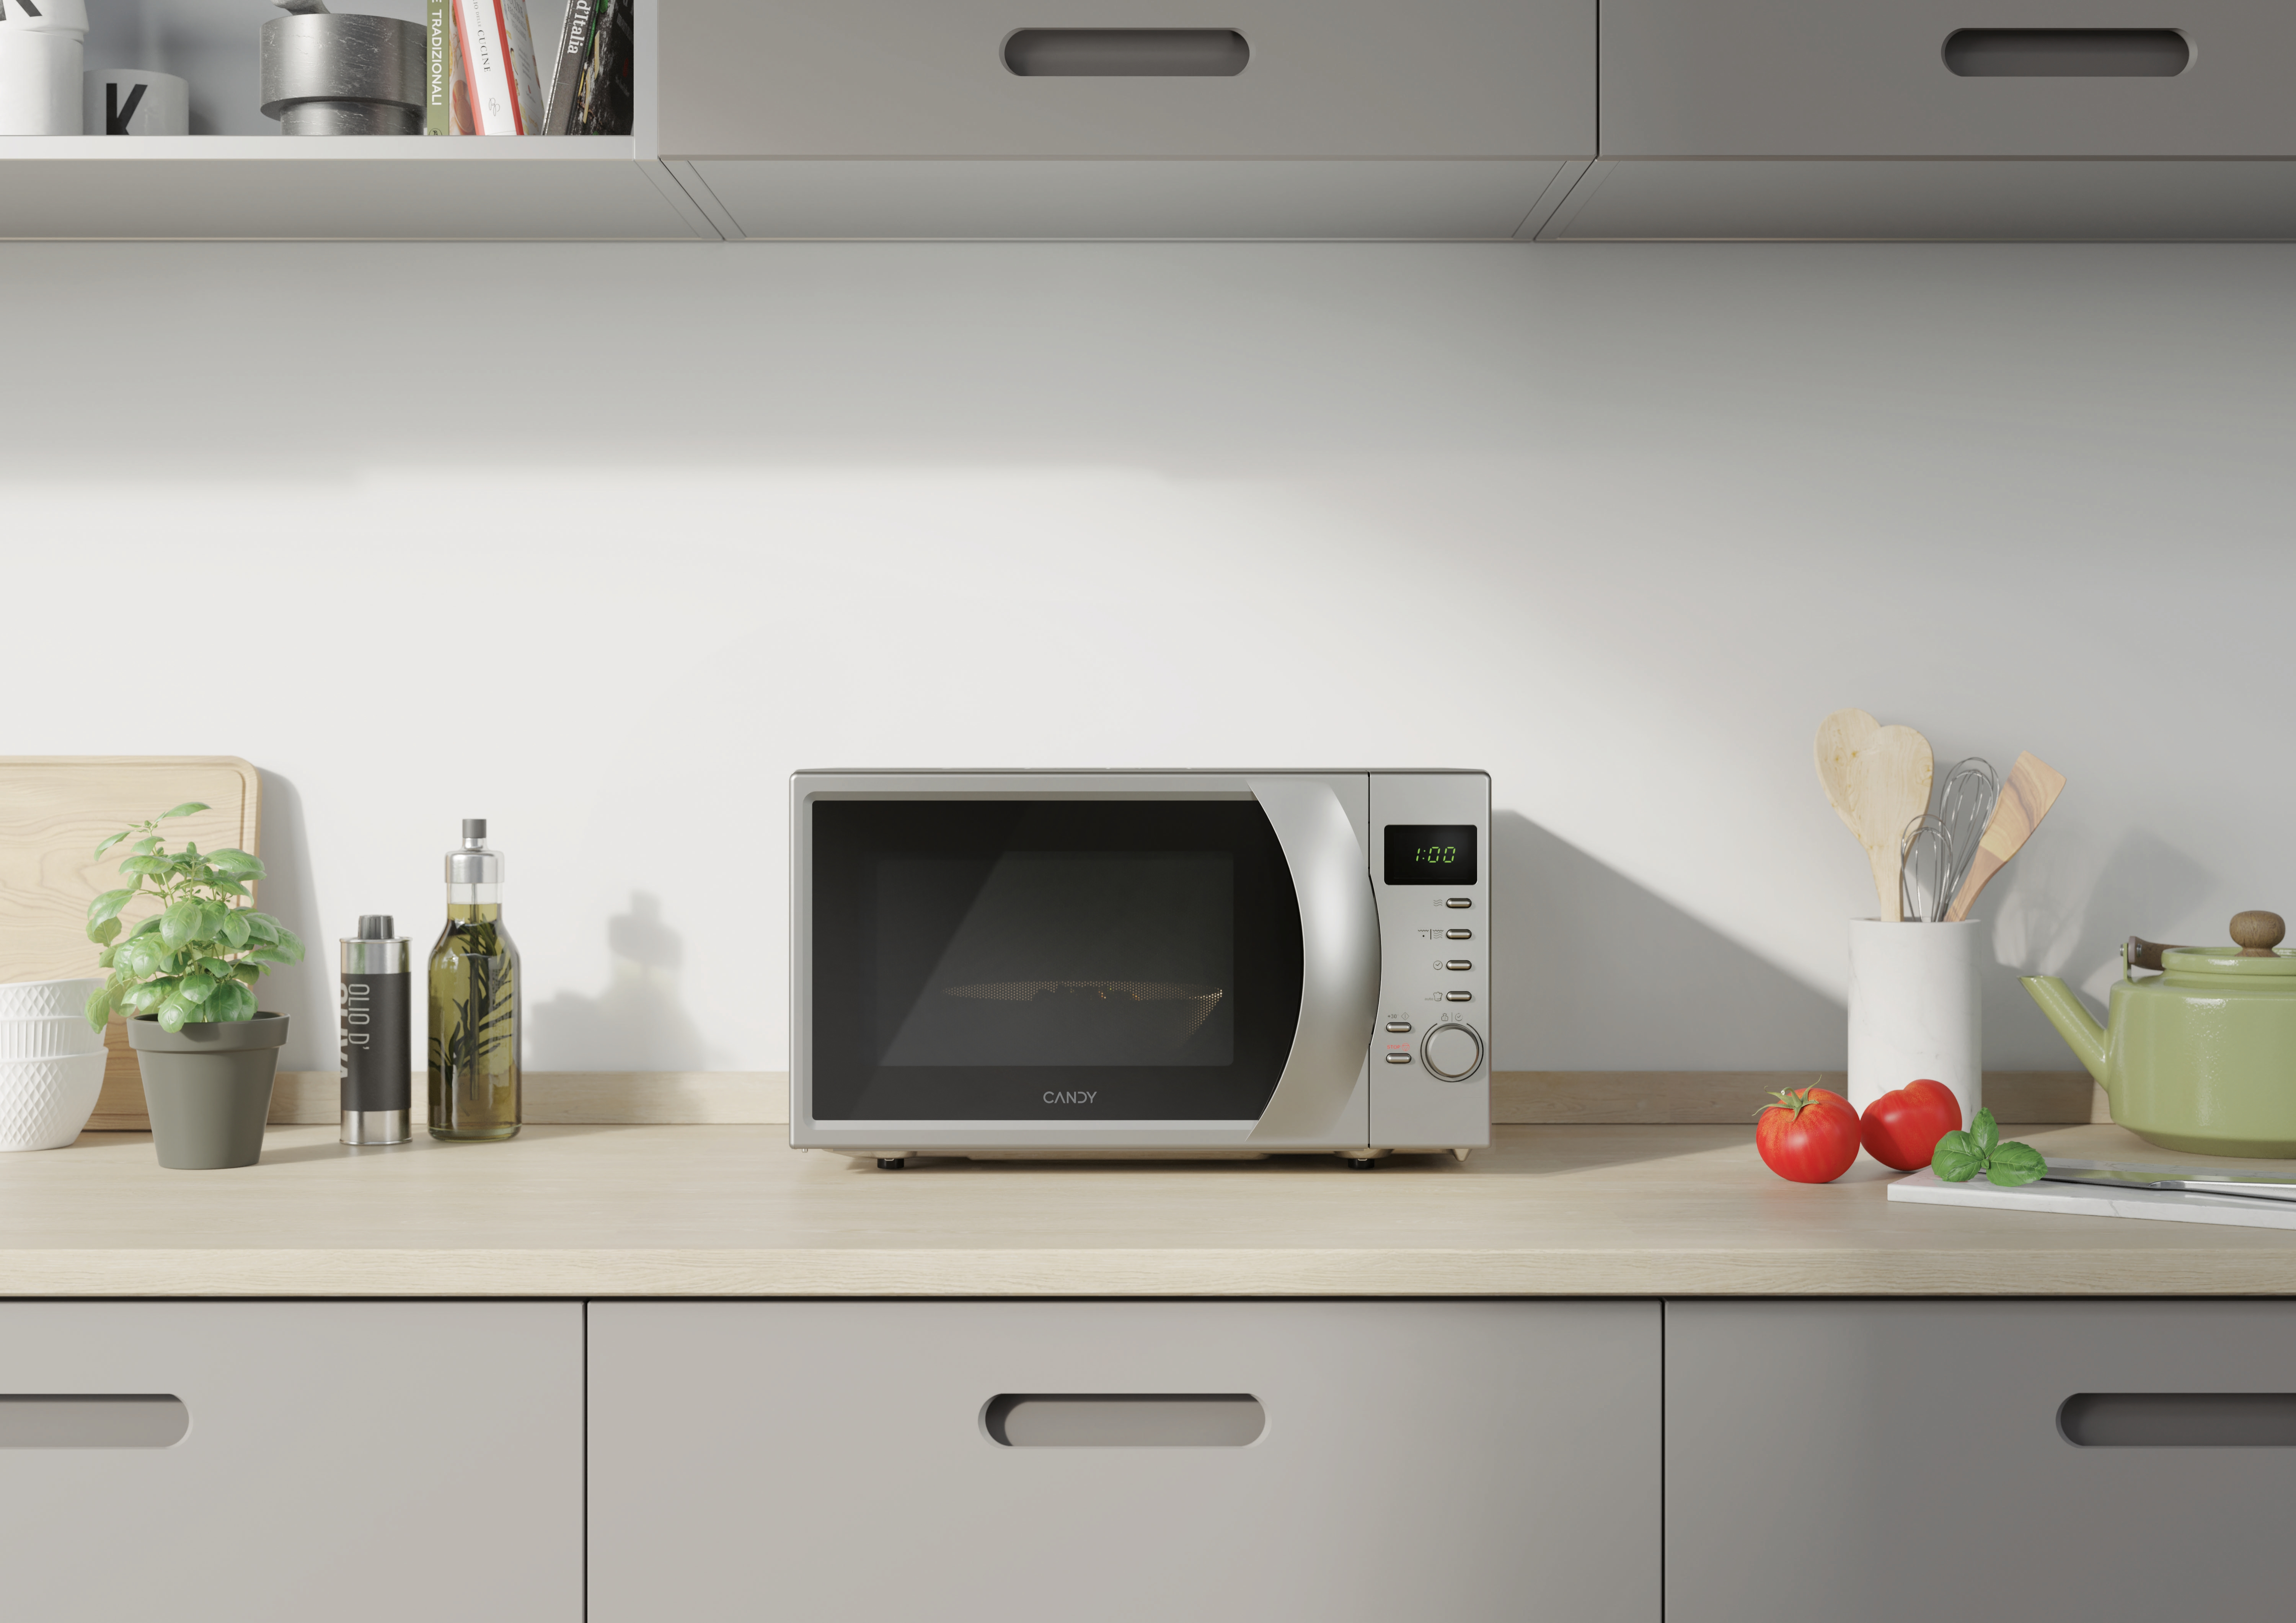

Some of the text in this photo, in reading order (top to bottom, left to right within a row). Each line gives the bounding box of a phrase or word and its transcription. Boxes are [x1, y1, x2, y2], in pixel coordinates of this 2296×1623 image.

[432, 9, 442, 105] TRADIZIONALI
[478, 30, 491, 72] CUCINE
[106, 83, 148, 135] K
[1416, 846, 1456, 863] 1:00
[348, 984, 370, 1025] OLIO
[1043, 1091, 1097, 1103] CANDY
